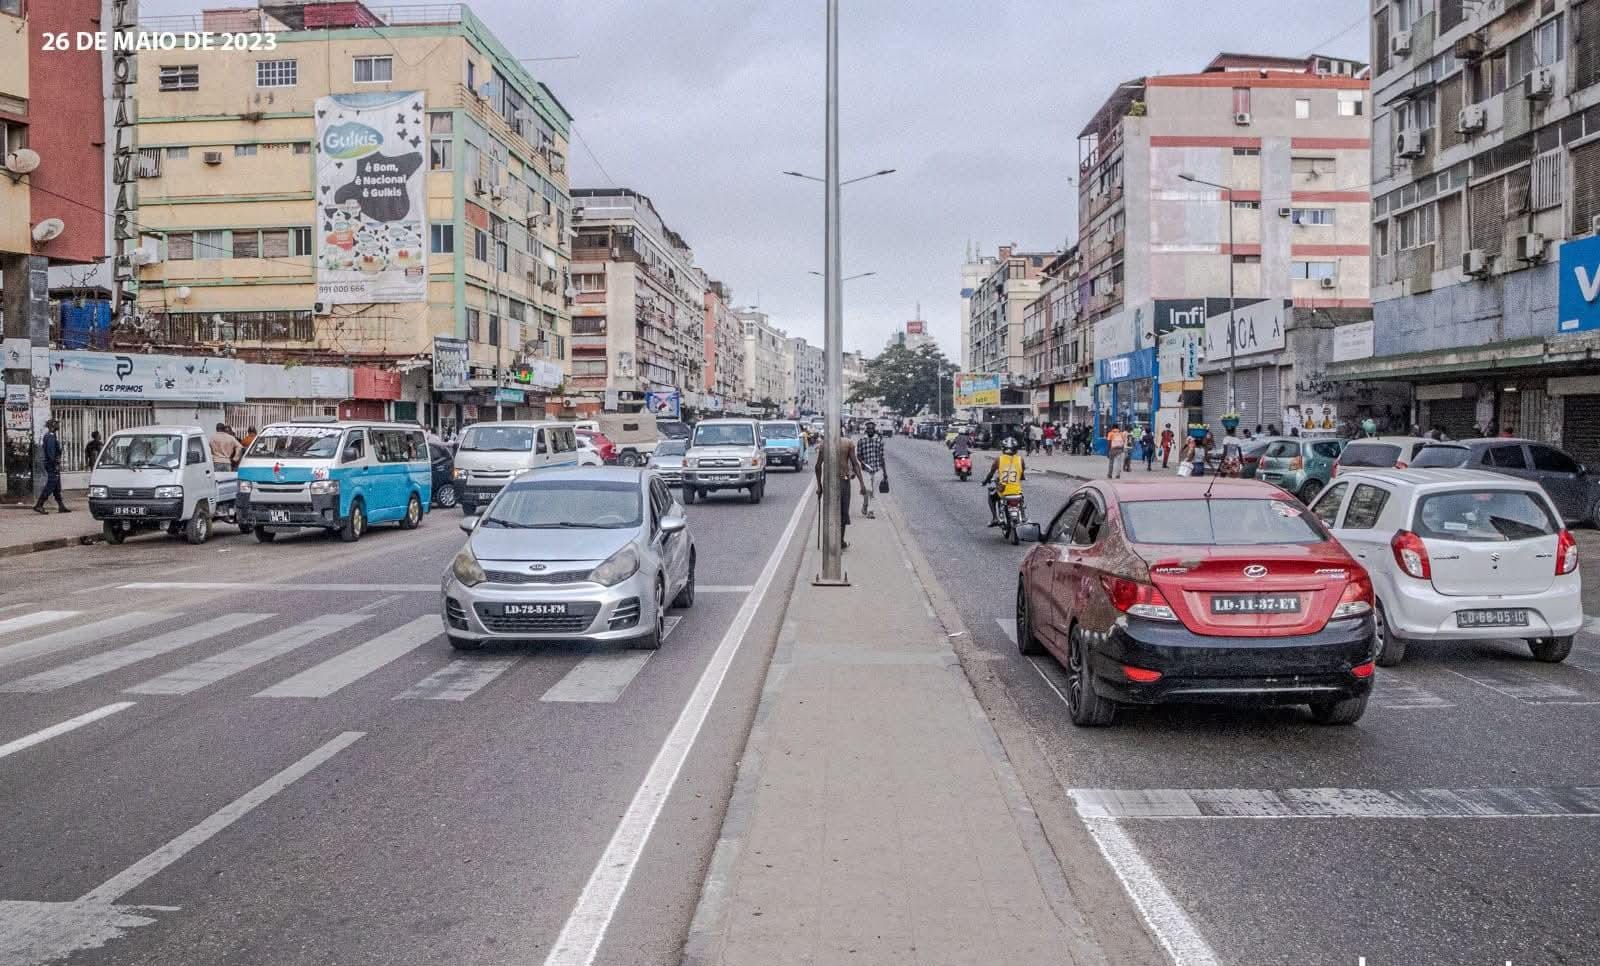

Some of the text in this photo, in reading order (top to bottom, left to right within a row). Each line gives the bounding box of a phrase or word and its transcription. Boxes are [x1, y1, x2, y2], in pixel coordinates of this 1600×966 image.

[326, 131, 377, 148] Gulkis
[365, 162, 399, 173] é Bom,
[355, 174, 408, 185] é Nacional
[362, 187, 402, 197] é Gulkis
[319, 286, 332, 294] 991
[99, 384, 144, 393] LOS PRIMOS
[1001, 470, 1018, 483] 23
[504, 604, 566, 614] LD-72-51-FM
[1214, 598, 1297, 611] LD-11-37-ET
